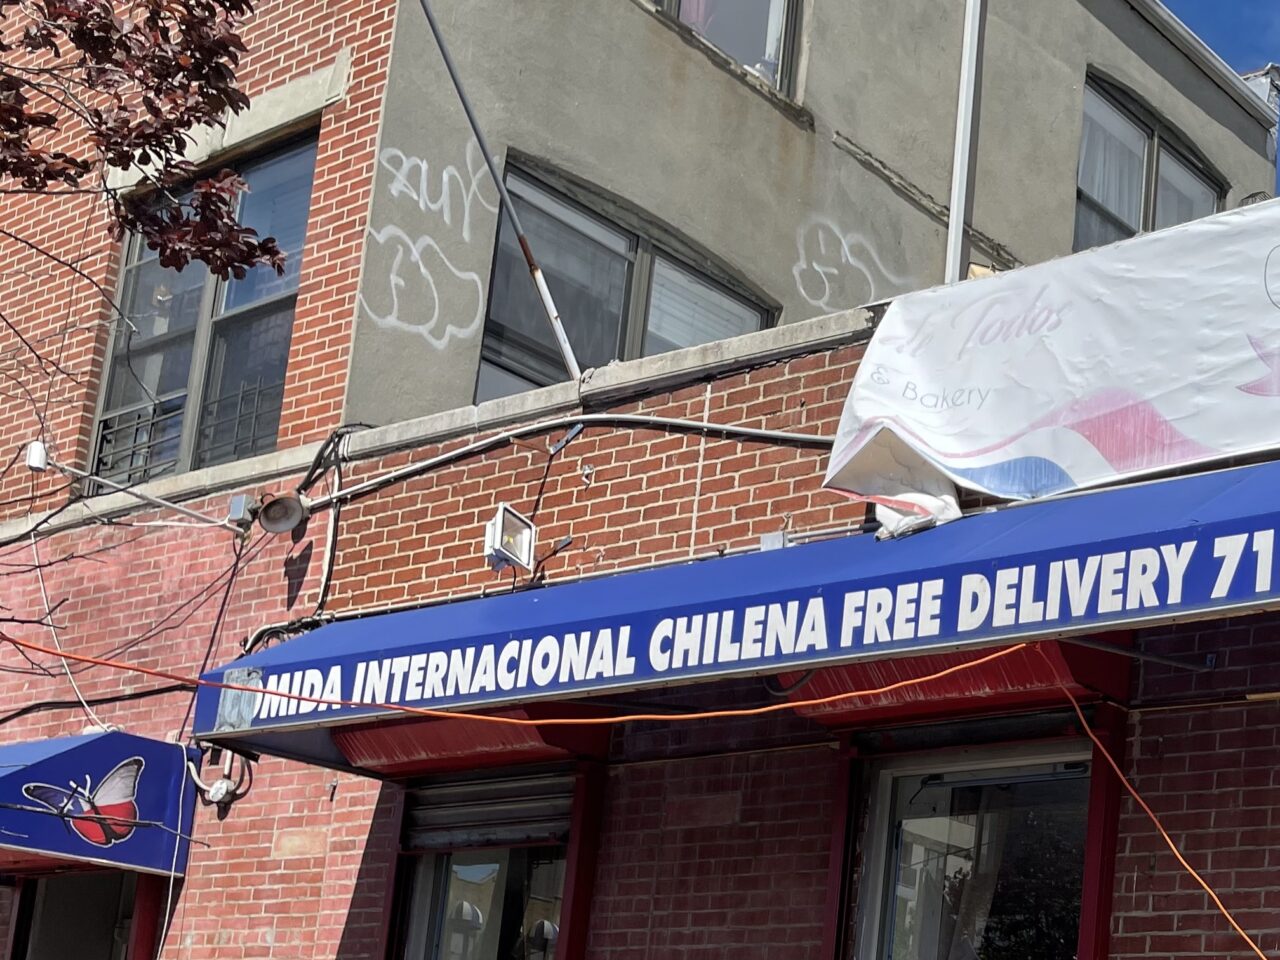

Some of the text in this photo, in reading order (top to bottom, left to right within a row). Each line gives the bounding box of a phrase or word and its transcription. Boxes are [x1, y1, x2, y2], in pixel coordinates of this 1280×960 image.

[951, 284, 1071, 361] Todos
[902, 381, 990, 410] Bakery
[352, 625, 636, 706] INTERNACIONAL
[648, 596, 828, 672] CHILENA
[840, 578, 944, 647] FREE
[957, 540, 1199, 633] DELIVERY
